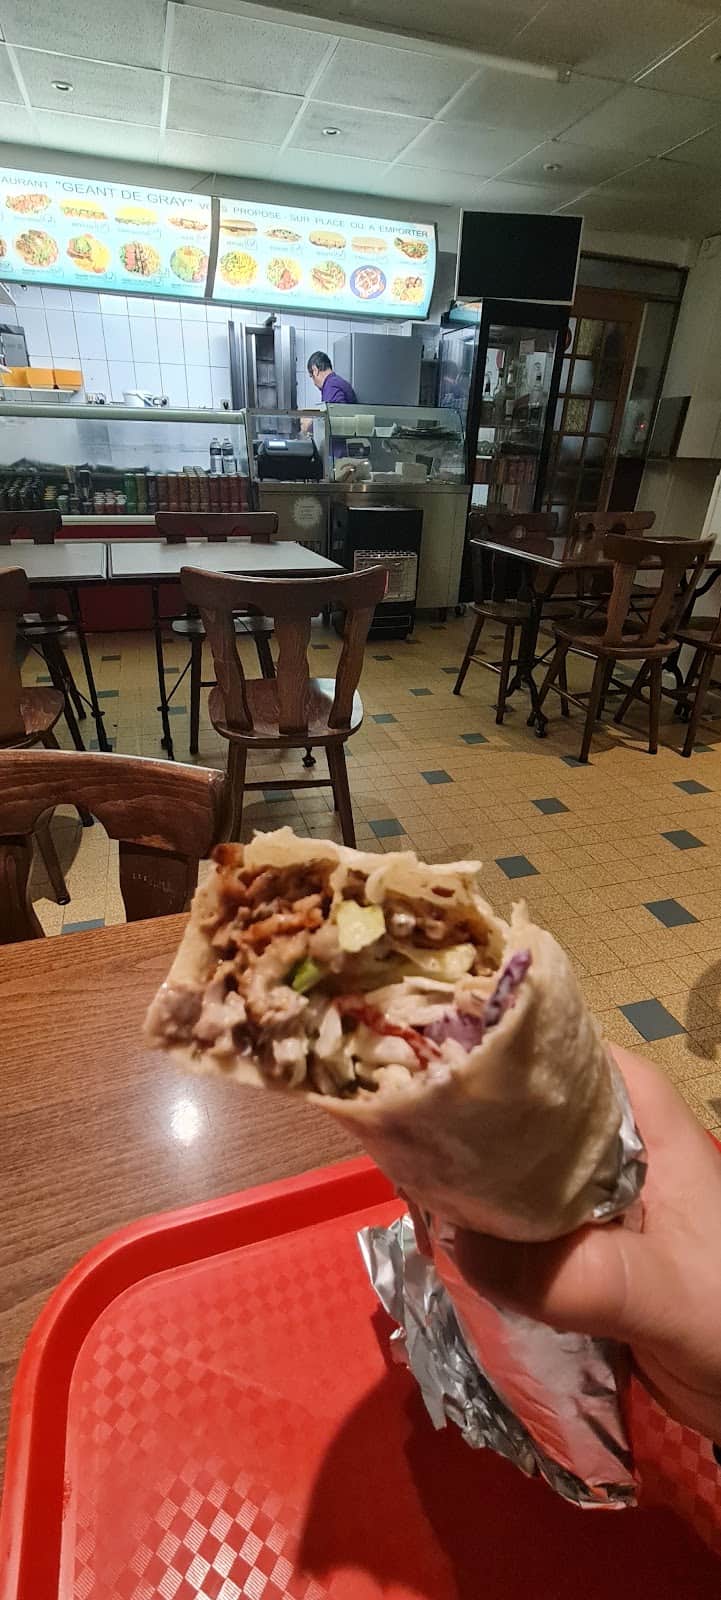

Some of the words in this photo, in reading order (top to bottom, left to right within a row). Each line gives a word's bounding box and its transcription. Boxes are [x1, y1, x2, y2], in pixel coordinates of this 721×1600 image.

[56, 180, 116, 200] "GEANT
[121, 189, 143, 201] DE
[147, 193, 193, 207] GRAY"
[233, 206, 281, 220] PROPOSE
[290, 214, 310, 224] SUR
[315, 216, 345, 228] PLACE
[350, 221, 365, 230] OU
[369, 223, 376, 232] A
[379, 225, 429, 238] EMPORTER
